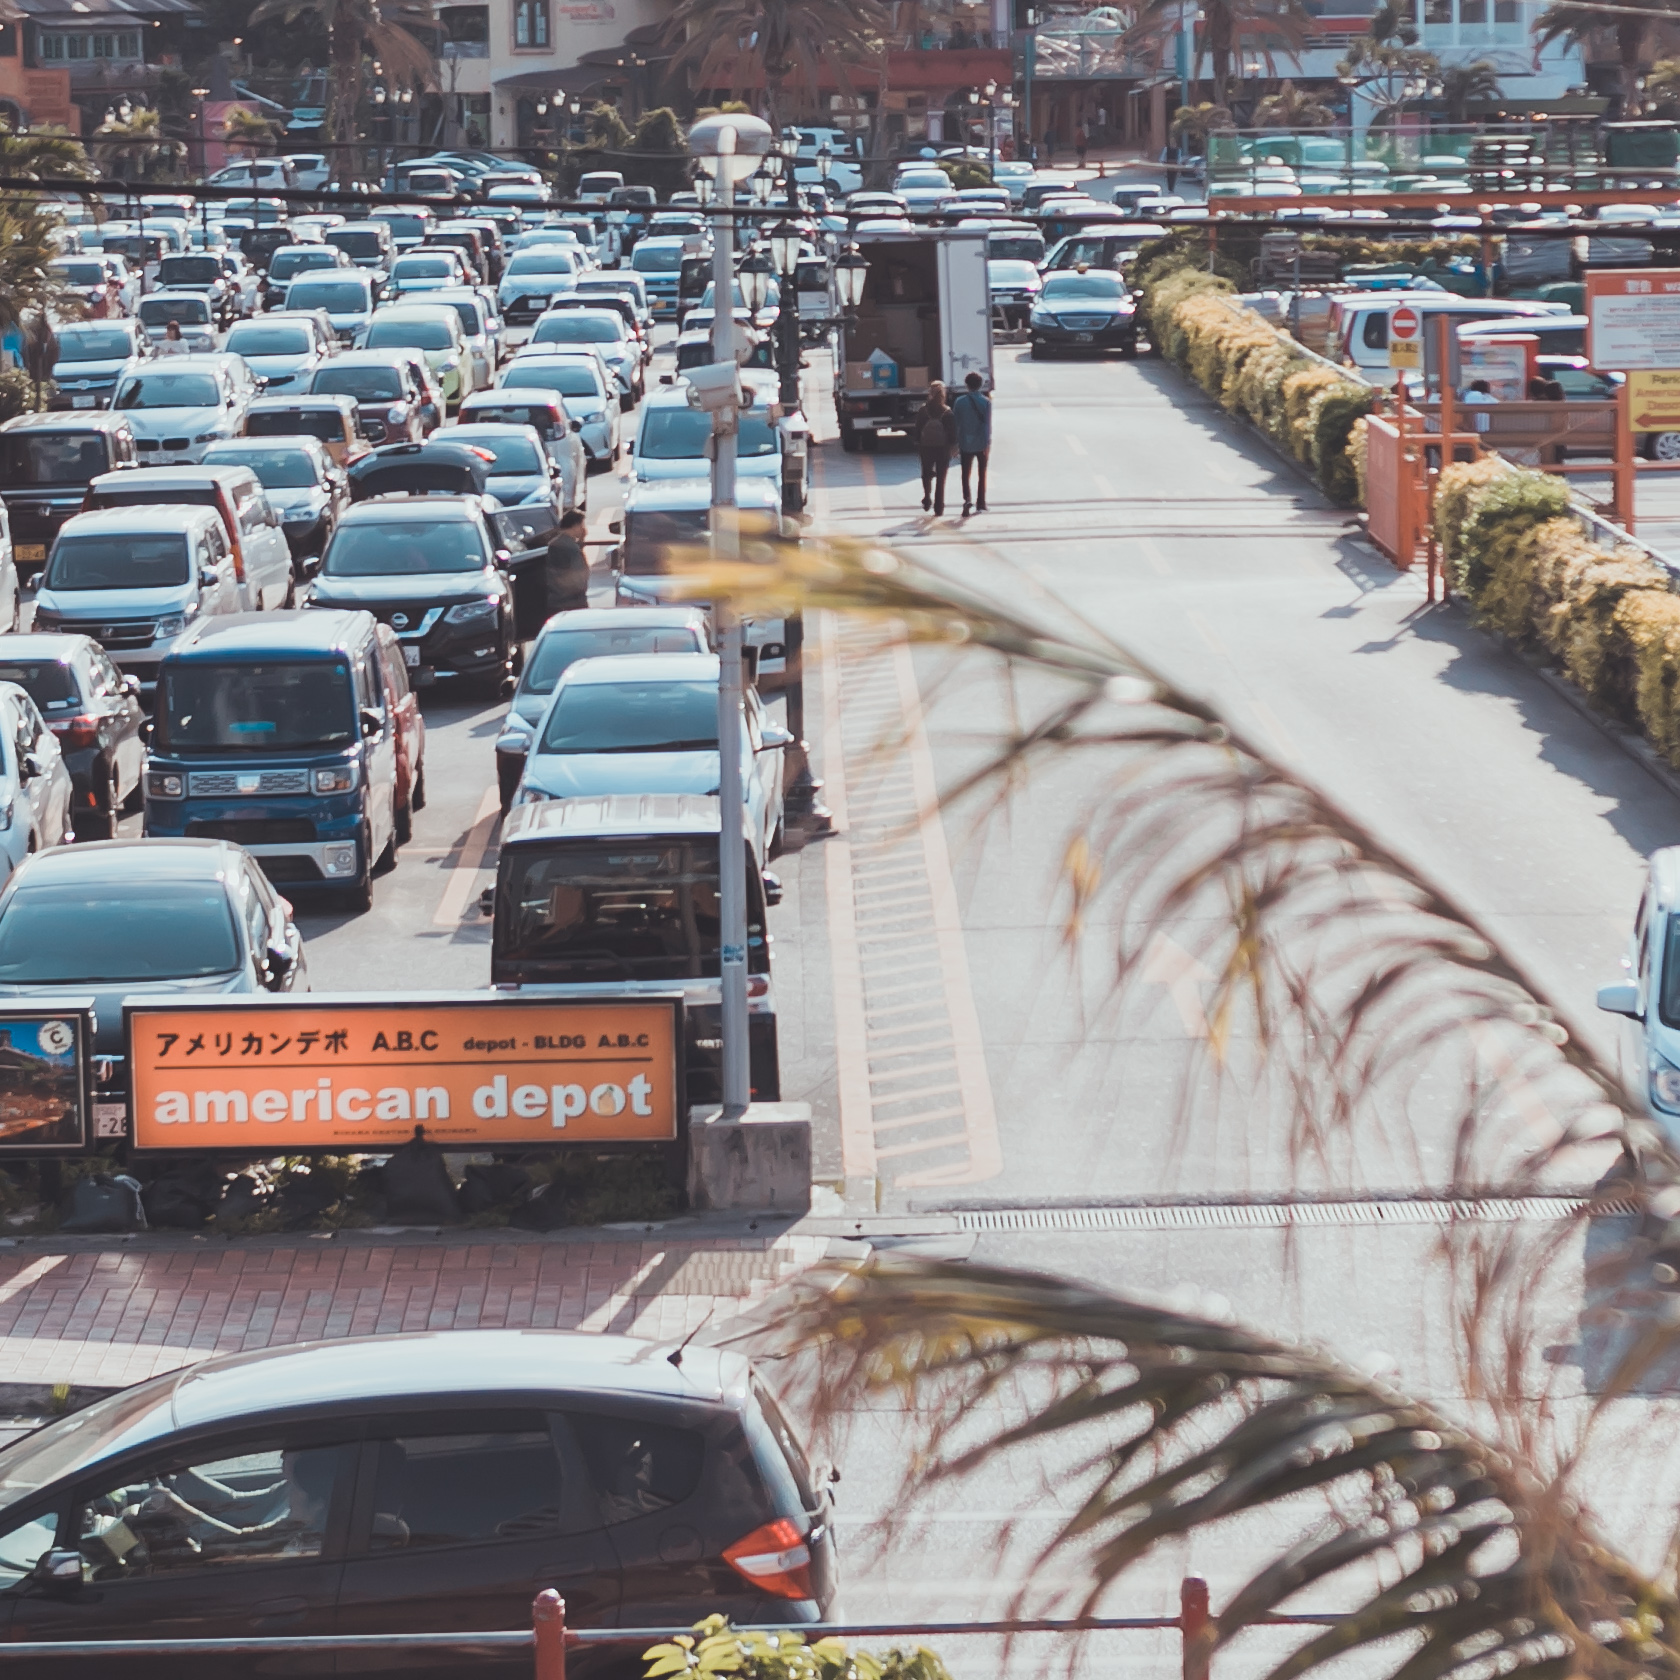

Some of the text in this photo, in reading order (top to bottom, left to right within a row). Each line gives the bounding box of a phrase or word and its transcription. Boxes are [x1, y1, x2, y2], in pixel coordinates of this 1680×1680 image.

[50, 1030, 64, 1044] C
[156, 1028, 350, 1058] アメリカンデポ
[372, 1031, 440, 1052] A.B.C
[463, 1035, 517, 1052] depot
[534, 1034, 586, 1050] BLDG
[598, 1033, 650, 1049] A.B.C
[154, 1071, 652, 1128] american depot
